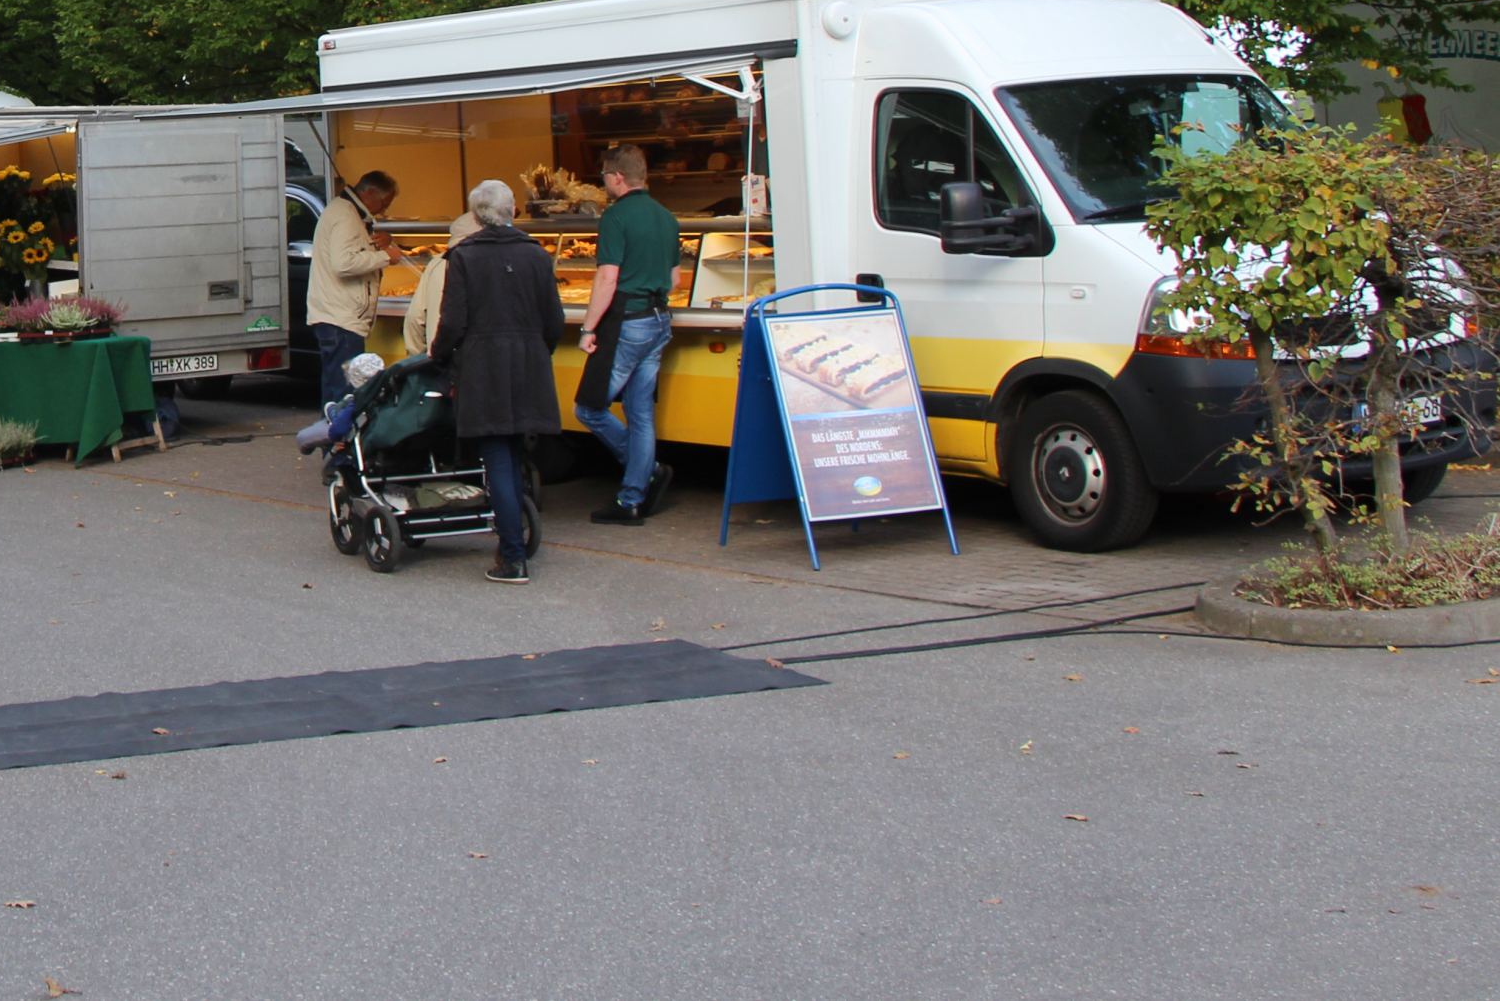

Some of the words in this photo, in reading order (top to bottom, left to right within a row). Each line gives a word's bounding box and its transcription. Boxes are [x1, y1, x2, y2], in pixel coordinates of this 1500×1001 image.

[152, 360, 169, 374] HH
[175, 358, 191, 372] XK
[194, 356, 215, 370] 389
[812, 432, 826, 444] DAS
[826, 430, 854, 442] LÄNGSTE
[835, 443, 850, 454] DES
[850, 440, 883, 451] NORDENS:
[814, 456, 839, 468] UNSERE
[840, 454, 866, 465] FRISCHE
